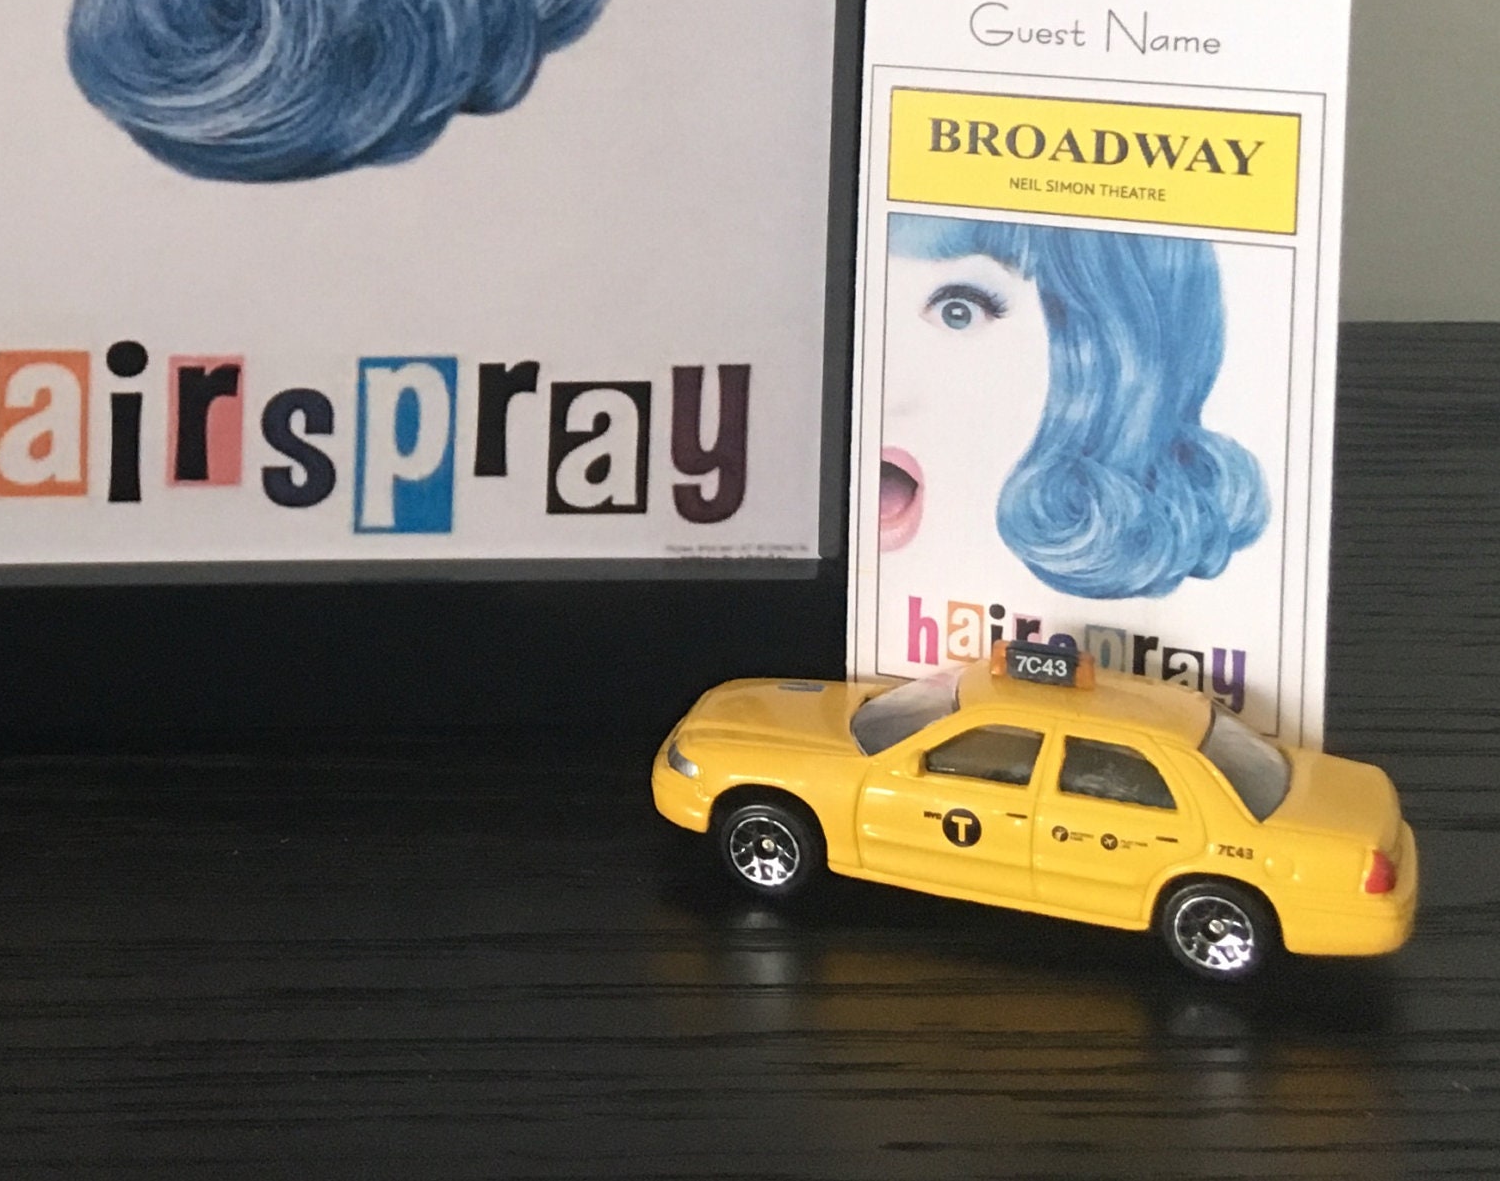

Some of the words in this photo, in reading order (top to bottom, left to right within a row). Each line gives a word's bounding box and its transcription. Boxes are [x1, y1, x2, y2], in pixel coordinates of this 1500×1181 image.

[969, 1, 1086, 46] Guest
[1105, 8, 1221, 55] Name
[927, 117, 1265, 177] BROADWAY
[1009, 176, 1042, 193] NEIL
[1045, 179, 1095, 196] SIMON
[1100, 184, 1166, 202] THEATRE
[1015, 654, 1068, 677] 7C43
[1217, 844, 1254, 861] 7C43
